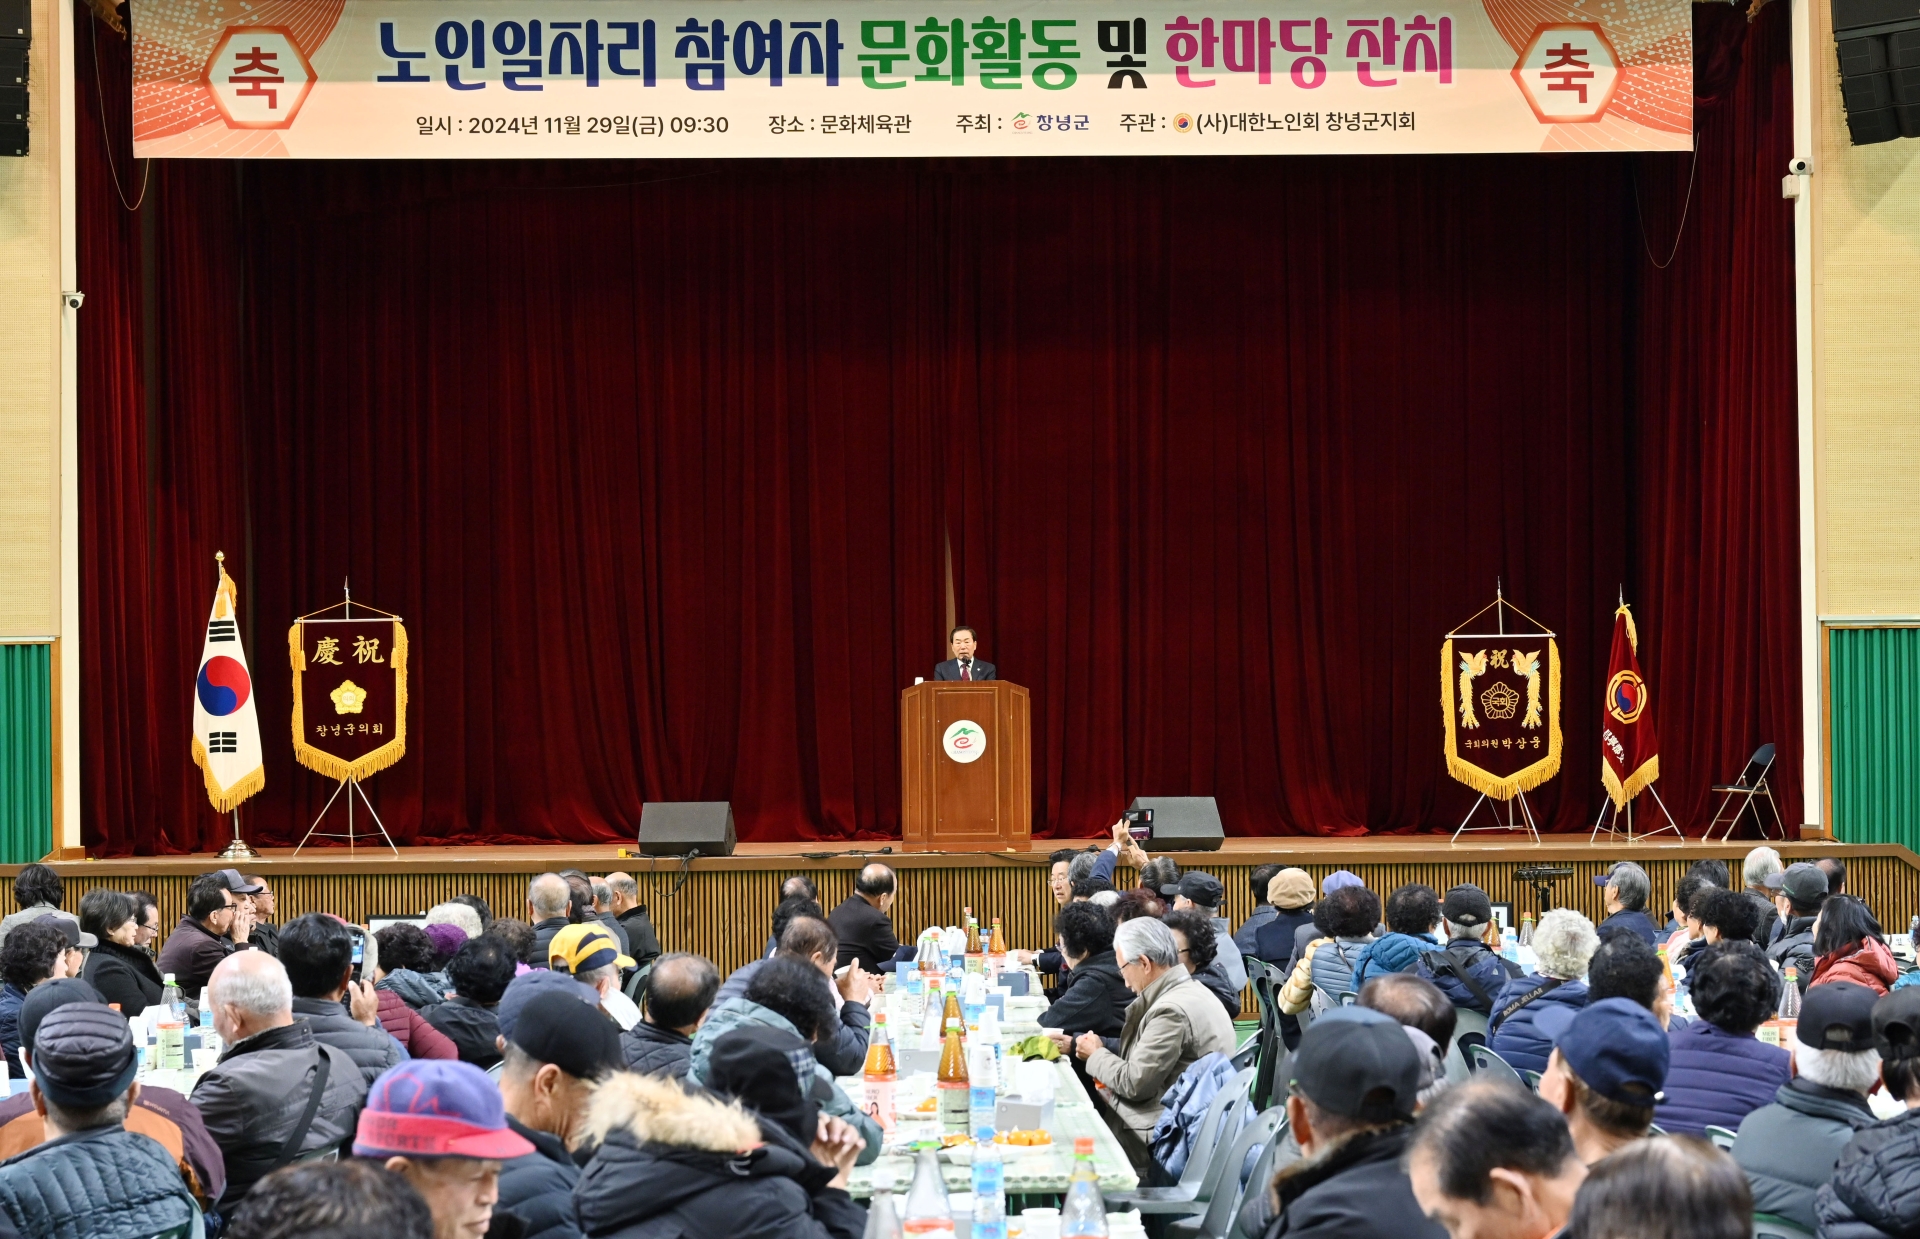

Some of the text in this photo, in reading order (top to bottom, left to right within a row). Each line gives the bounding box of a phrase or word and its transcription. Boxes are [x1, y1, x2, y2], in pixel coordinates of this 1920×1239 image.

[376, 14, 1454, 92] 노인일자리 참여자 문화활동 및 한마당 잔치
[228, 46, 286, 110] 축
[1539, 42, 1597, 104] 축
[416, 115, 452, 136] 일시
[468, 116, 539, 136] 2024년
[544, 115, 581, 136] 11월
[586, 115, 664, 138] 29일(금)
[670, 116, 729, 135] 09:30
[768, 114, 805, 135] 장소
[820, 113, 913, 135] 문화체육관
[955, 113, 991, 134] 주최
[1036, 114, 1090, 132] 창녕군
[1119, 112, 1157, 133] 주관
[1196, 111, 1321, 135] (사)대한노인회
[1325, 111, 1415, 132] 창녕군지회
[315, 722, 384, 737] 창녕군의회
[1464, 738, 1499, 750] 국회의원
